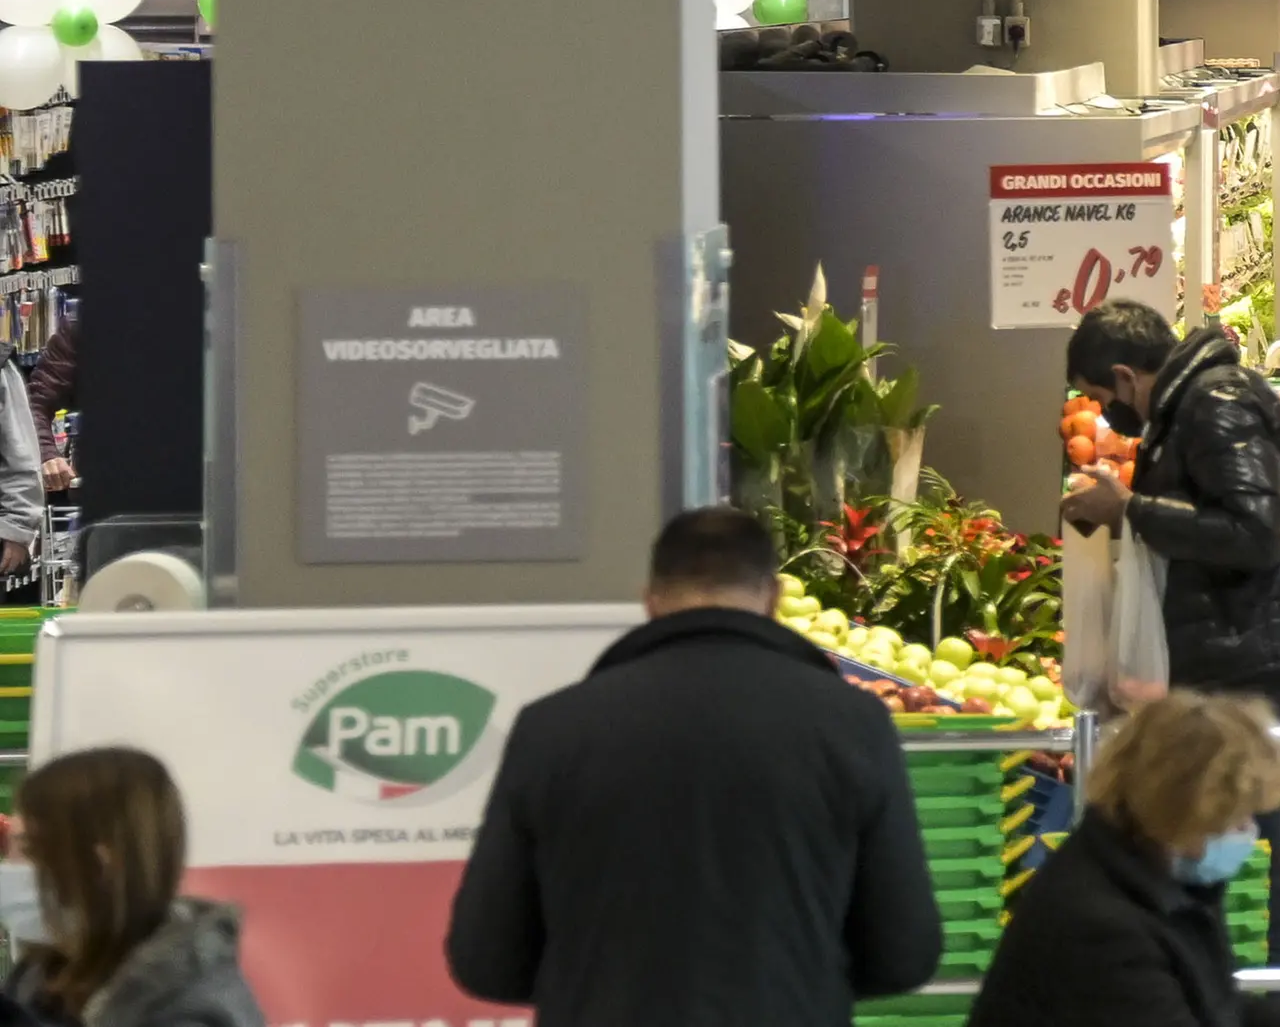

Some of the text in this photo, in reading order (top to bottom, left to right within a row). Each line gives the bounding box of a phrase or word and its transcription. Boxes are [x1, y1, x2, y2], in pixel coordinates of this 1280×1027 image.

[1002, 173, 1162, 190] GRANDI OCCASIONI
[1001, 203, 1136, 223] ARANCE NAVEL KG
[408, 306, 476, 328] AREA
[322, 337, 560, 362] VIDEOSORVEGLIATA
[290, 648, 411, 714] Superstore
[328, 705, 460, 757] Pam
[273, 828, 439, 847] LA VITA SPESA AL
